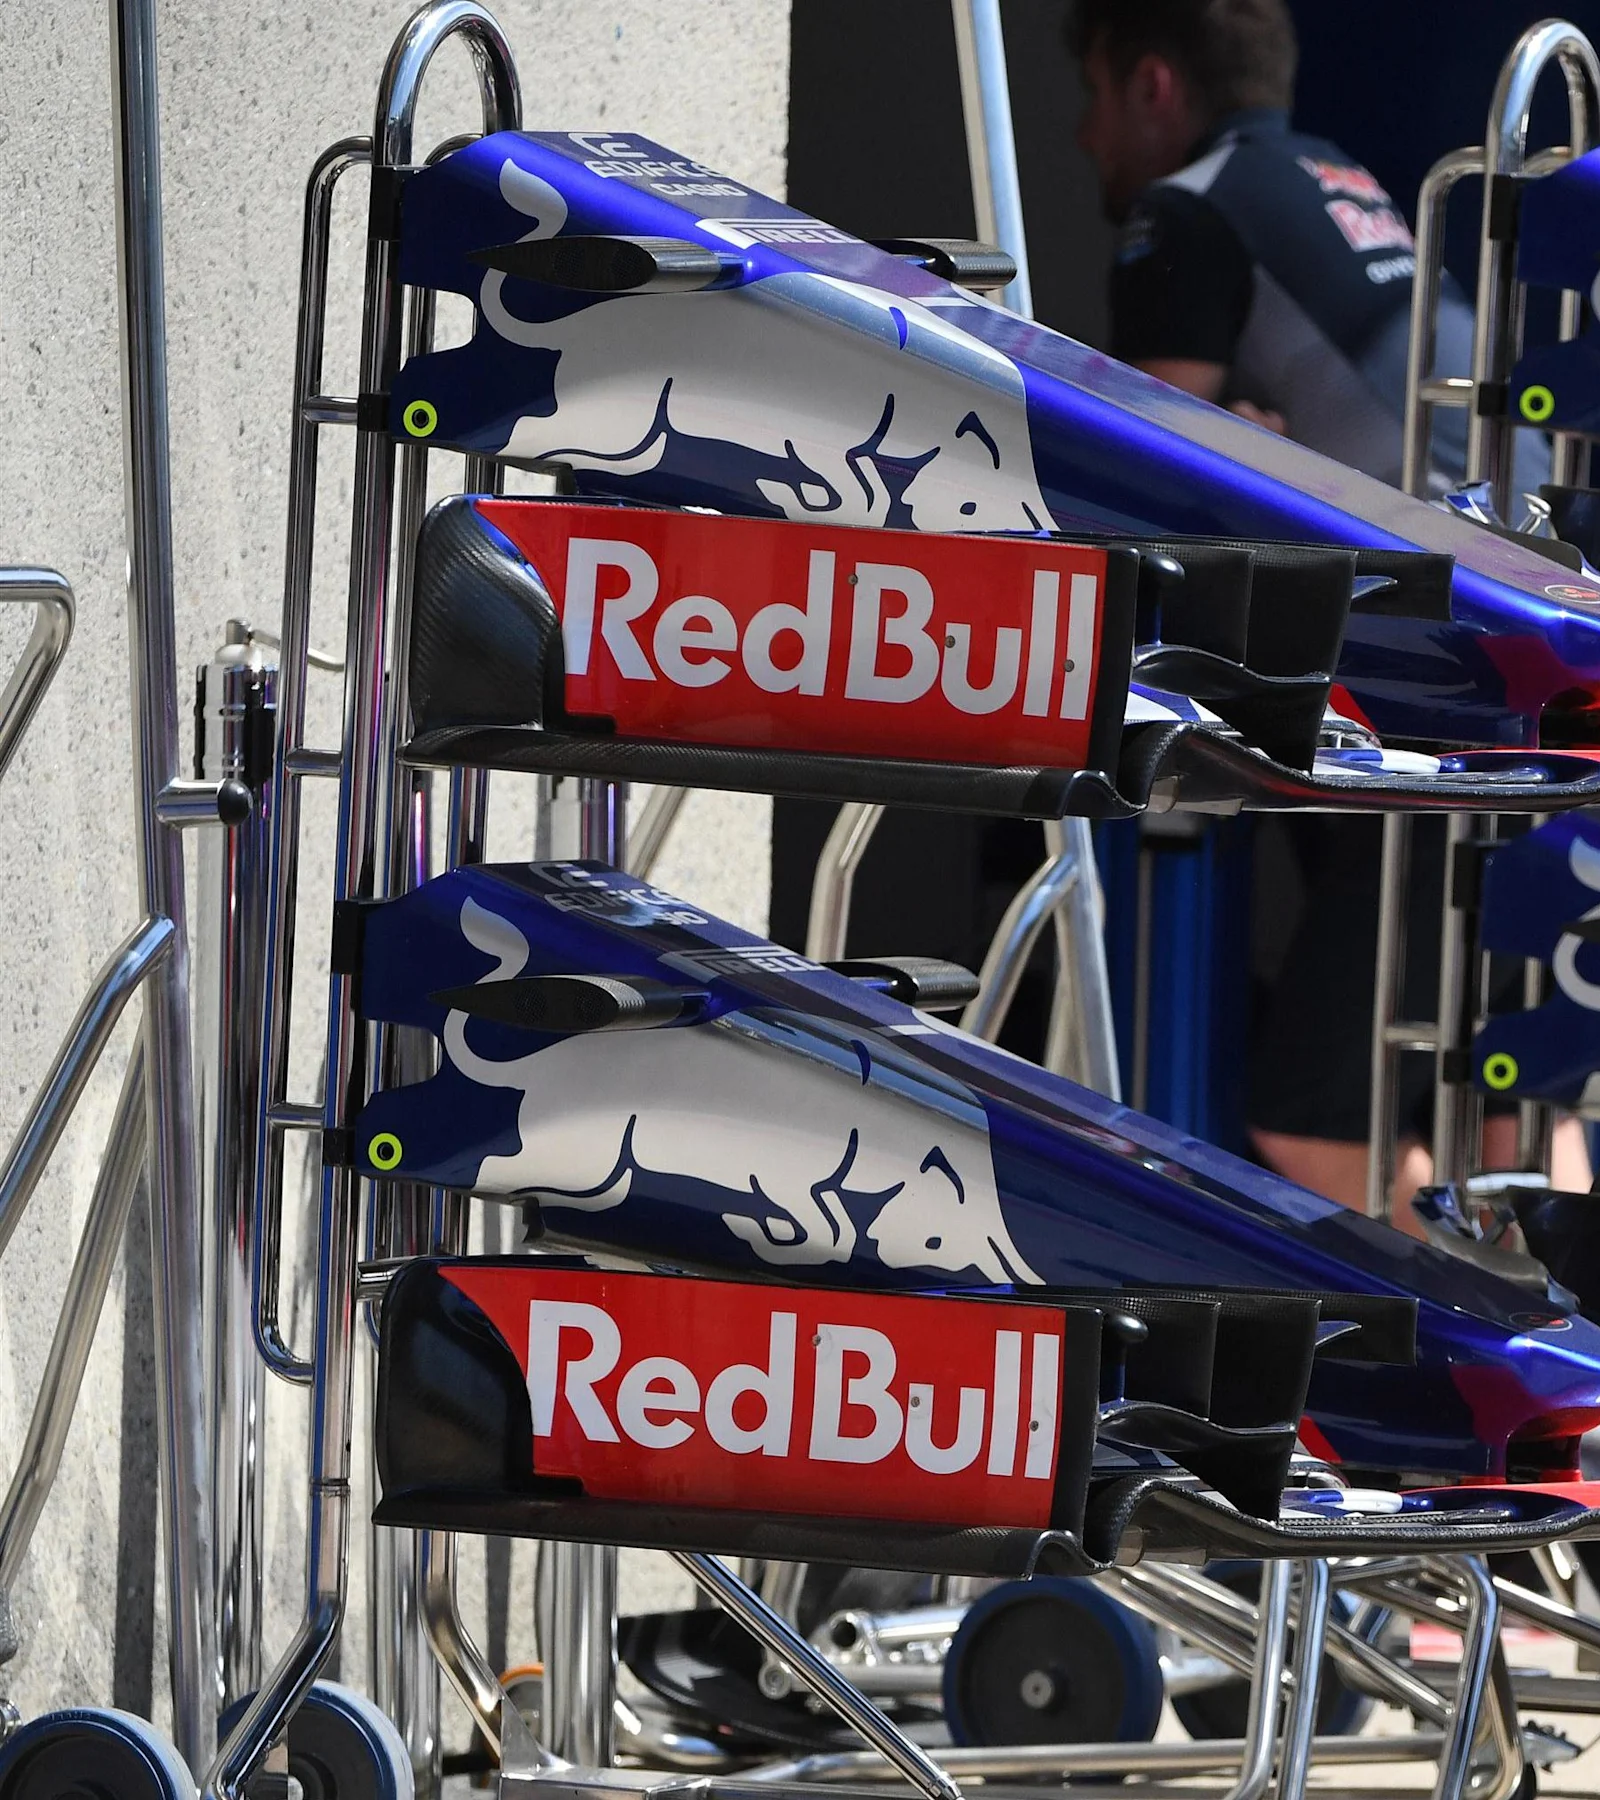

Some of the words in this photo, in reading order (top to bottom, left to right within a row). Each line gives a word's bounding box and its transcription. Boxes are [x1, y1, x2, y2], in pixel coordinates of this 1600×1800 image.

[650, 183, 748, 196] CASIO
[695, 218, 866, 250] PIRELL
[657, 945, 828, 984] PIRELL
